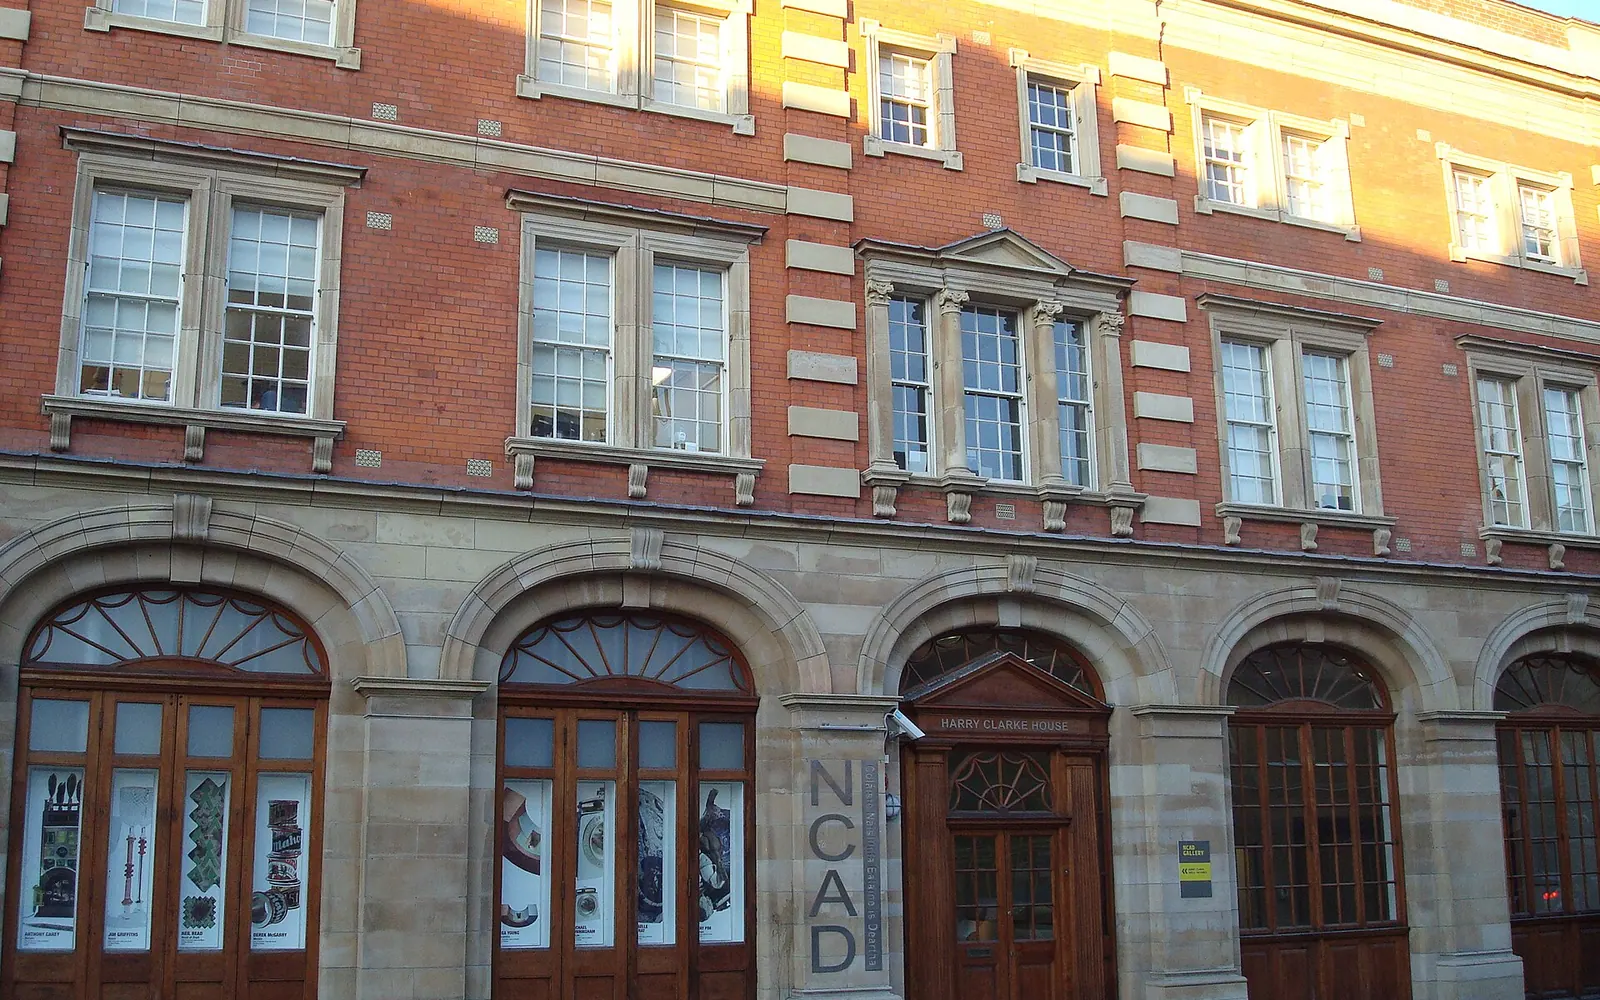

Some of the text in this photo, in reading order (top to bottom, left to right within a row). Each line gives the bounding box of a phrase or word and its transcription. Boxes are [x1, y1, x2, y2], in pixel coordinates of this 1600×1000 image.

[941, 718, 1069, 731] HARRY CLARKE HOUSE
